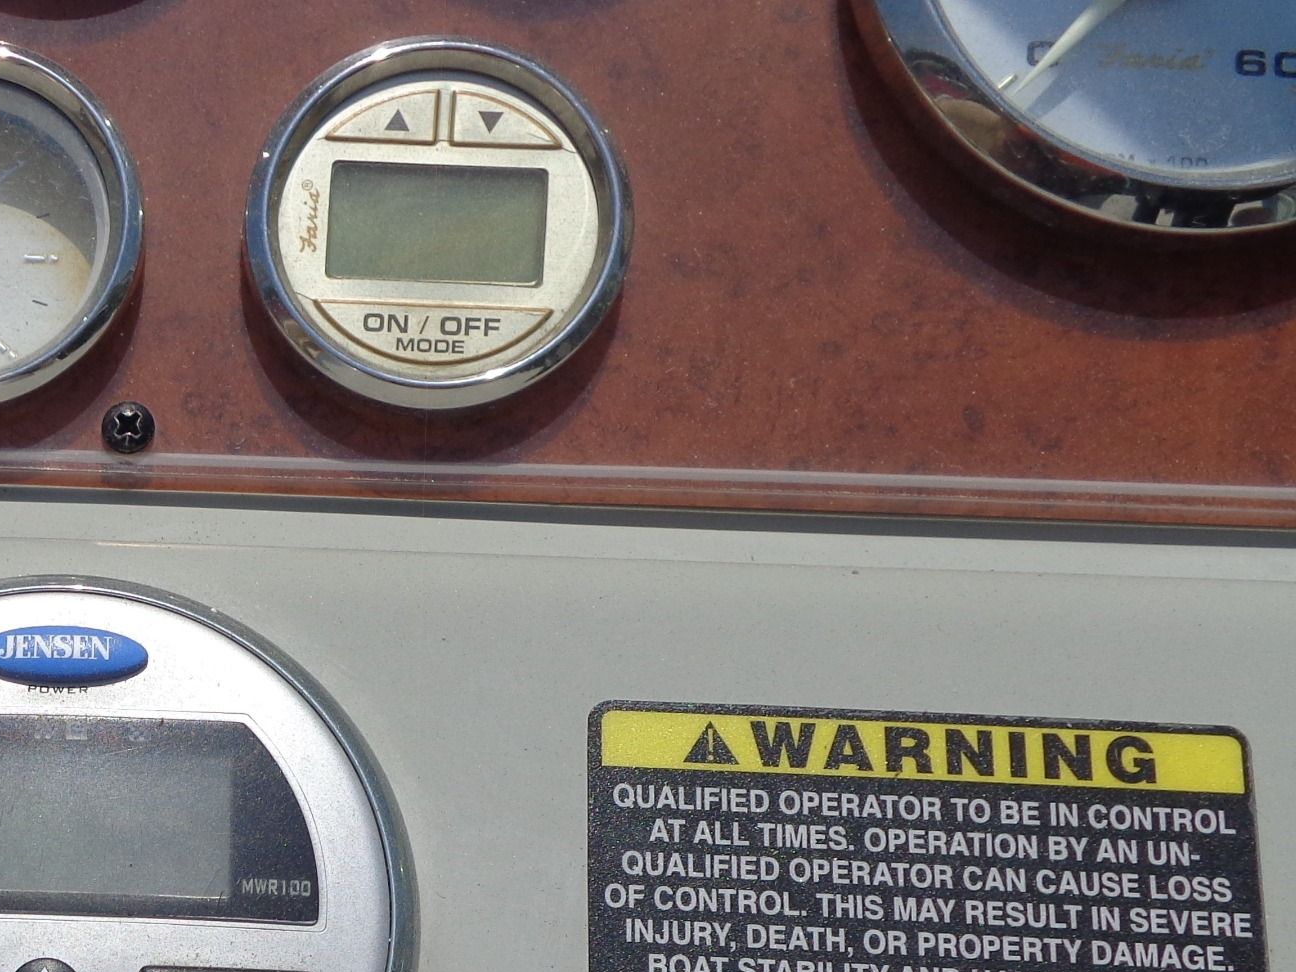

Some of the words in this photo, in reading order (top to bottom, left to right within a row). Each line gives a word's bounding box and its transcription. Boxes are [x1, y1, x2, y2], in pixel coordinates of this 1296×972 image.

[363, 313, 409, 334] ON
[440, 315, 501, 337] OFF
[396, 337, 465, 355] MODE
[27, 684, 89, 694] POWER
[750, 721, 1157, 784] WARNING
[613, 783, 770, 814] QUALIFIED
[779, 789, 942, 820] OPERATOR
[950, 797, 991, 822] TO
[1000, 800, 1041, 826] BE
[1050, 802, 1079, 827] IN
[1088, 803, 1237, 835] CONTROL
[649, 819, 686, 843] AT
[693, 820, 750, 846] ALL
[758, 822, 855, 852] TIMES.
[864, 827, 1039, 859] OPERATION
[1048, 836, 1088, 862] BY
[1097, 839, 1138, 864] AN
[1147, 841, 1200, 866] UN-
[242, 878, 311, 896] MWR100
[622, 850, 780, 881] QUALIFIED
[789, 856, 954, 889] OPERATOR
[963, 866, 1026, 892] CAN
[1036, 869, 1140, 898] CAUSE
[1150, 874, 1233, 902] LOSS
[604, 883, 645, 908] OF
[653, 886, 807, 917] CONTROL.
[816, 893, 884, 920] THIS
[893, 897, 956, 923] MAY
[965, 900, 1082, 930] RESULT
[1092, 906, 1120, 932] IN
[1129, 908, 1253, 938] SEVERE
[625, 918, 737, 952] INJURY,
[747, 923, 854, 957] DEATH,
[863, 928, 908, 955] OR
[918, 932, 1083, 964] PROPERTY
[1092, 939, 1235, 972] DAMAGE.
